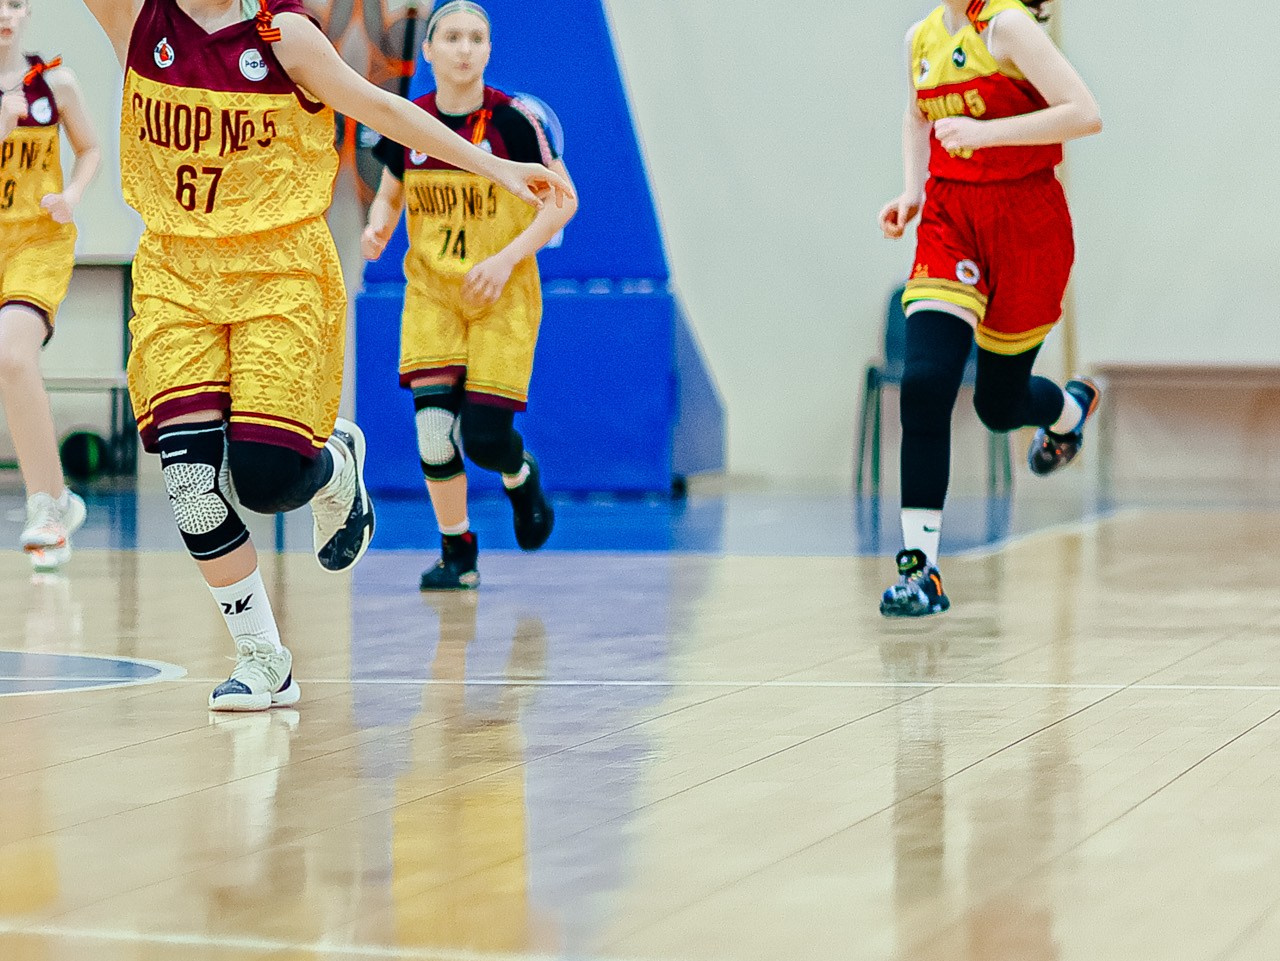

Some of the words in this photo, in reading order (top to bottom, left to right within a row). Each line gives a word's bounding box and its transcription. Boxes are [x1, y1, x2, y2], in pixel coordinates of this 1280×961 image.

[132, 92, 211, 153] СШОР
[257, 109, 279, 147] 5
[964, 89, 986, 117] 5
[175, 164, 223, 214] 67
[438, 226, 466, 261] 74
